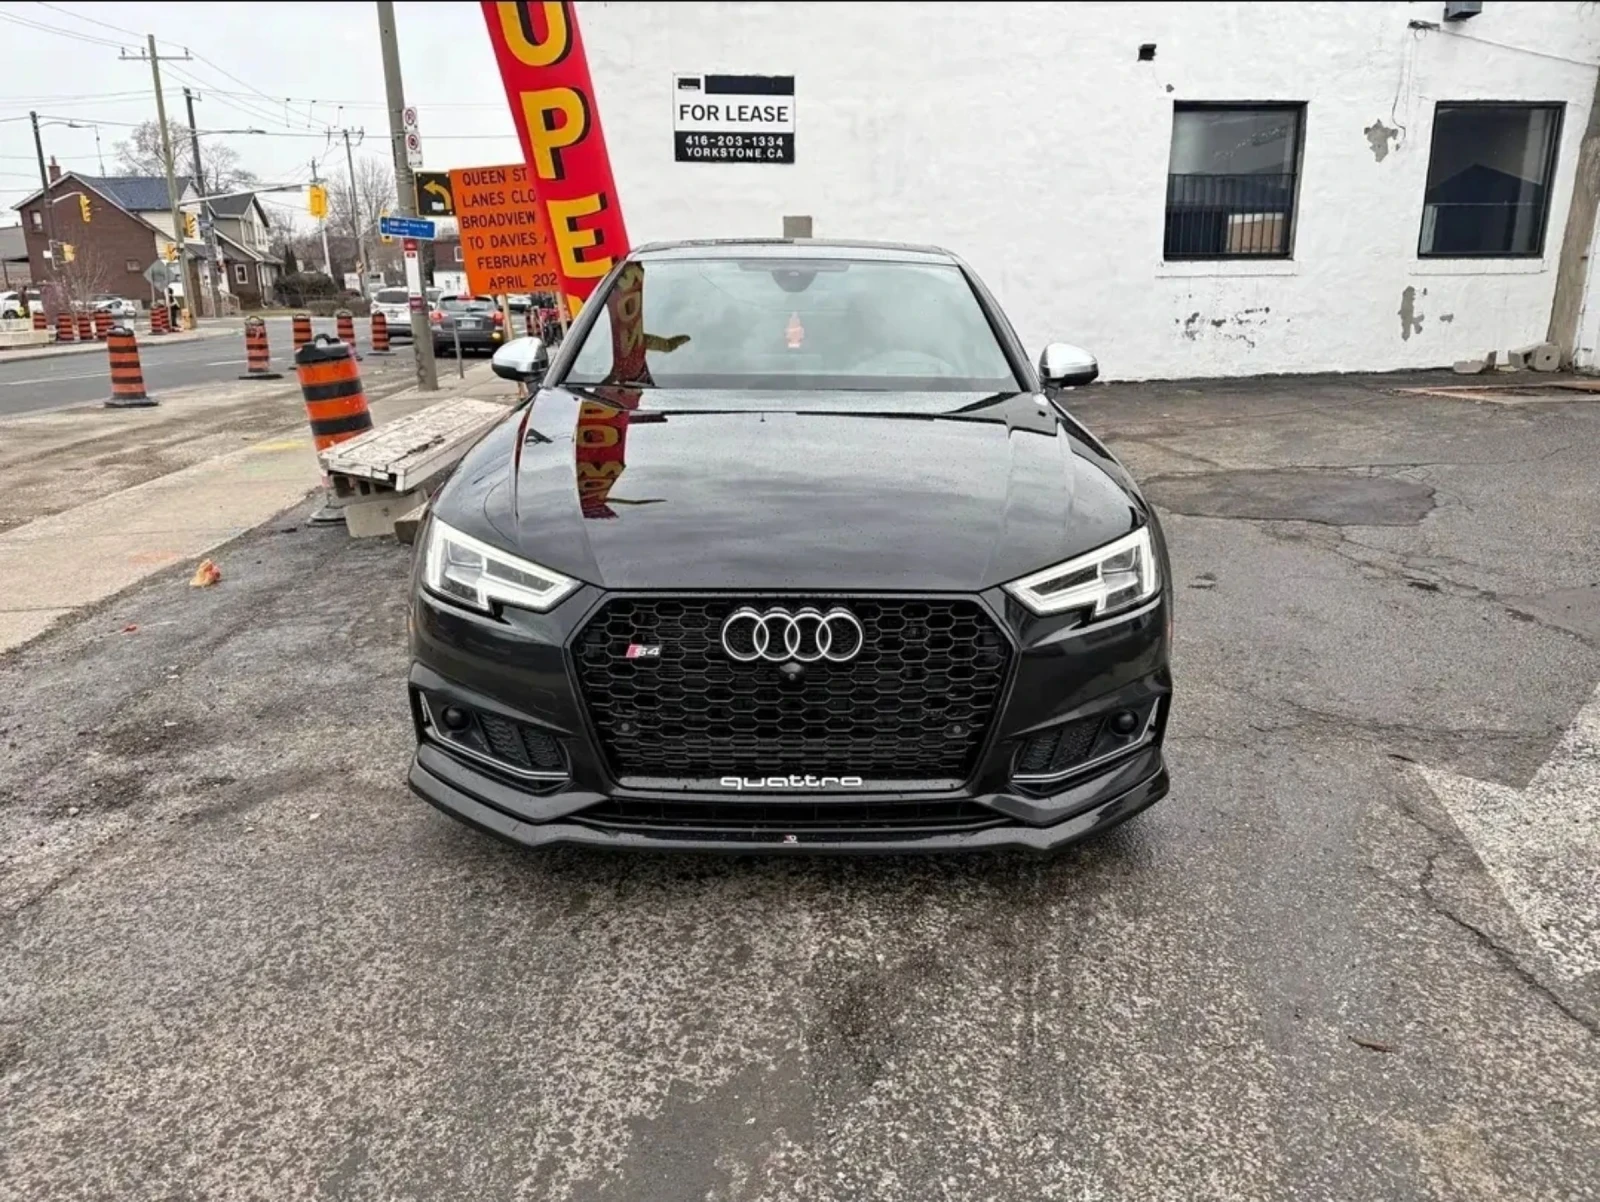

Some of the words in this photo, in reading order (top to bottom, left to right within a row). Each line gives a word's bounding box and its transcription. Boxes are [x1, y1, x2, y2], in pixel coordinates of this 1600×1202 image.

[680, 104, 719, 121] FOR
[726, 105, 789, 122] LEASE
[685, 135, 784, 147] 416-203-1334
[685, 147, 784, 158] YORKSTONE.CA
[462, 169, 506, 187] QUEEN
[512, 167, 527, 182] ST
[462, 191, 505, 208] LANES
[461, 210, 535, 229] BROADVIEW
[467, 235, 485, 250] TO
[490, 232, 538, 249] DAVIES
[477, 252, 547, 270] FEBRUARY
[489, 274, 527, 290] APRIL
[720, 774, 863, 790] quattro
